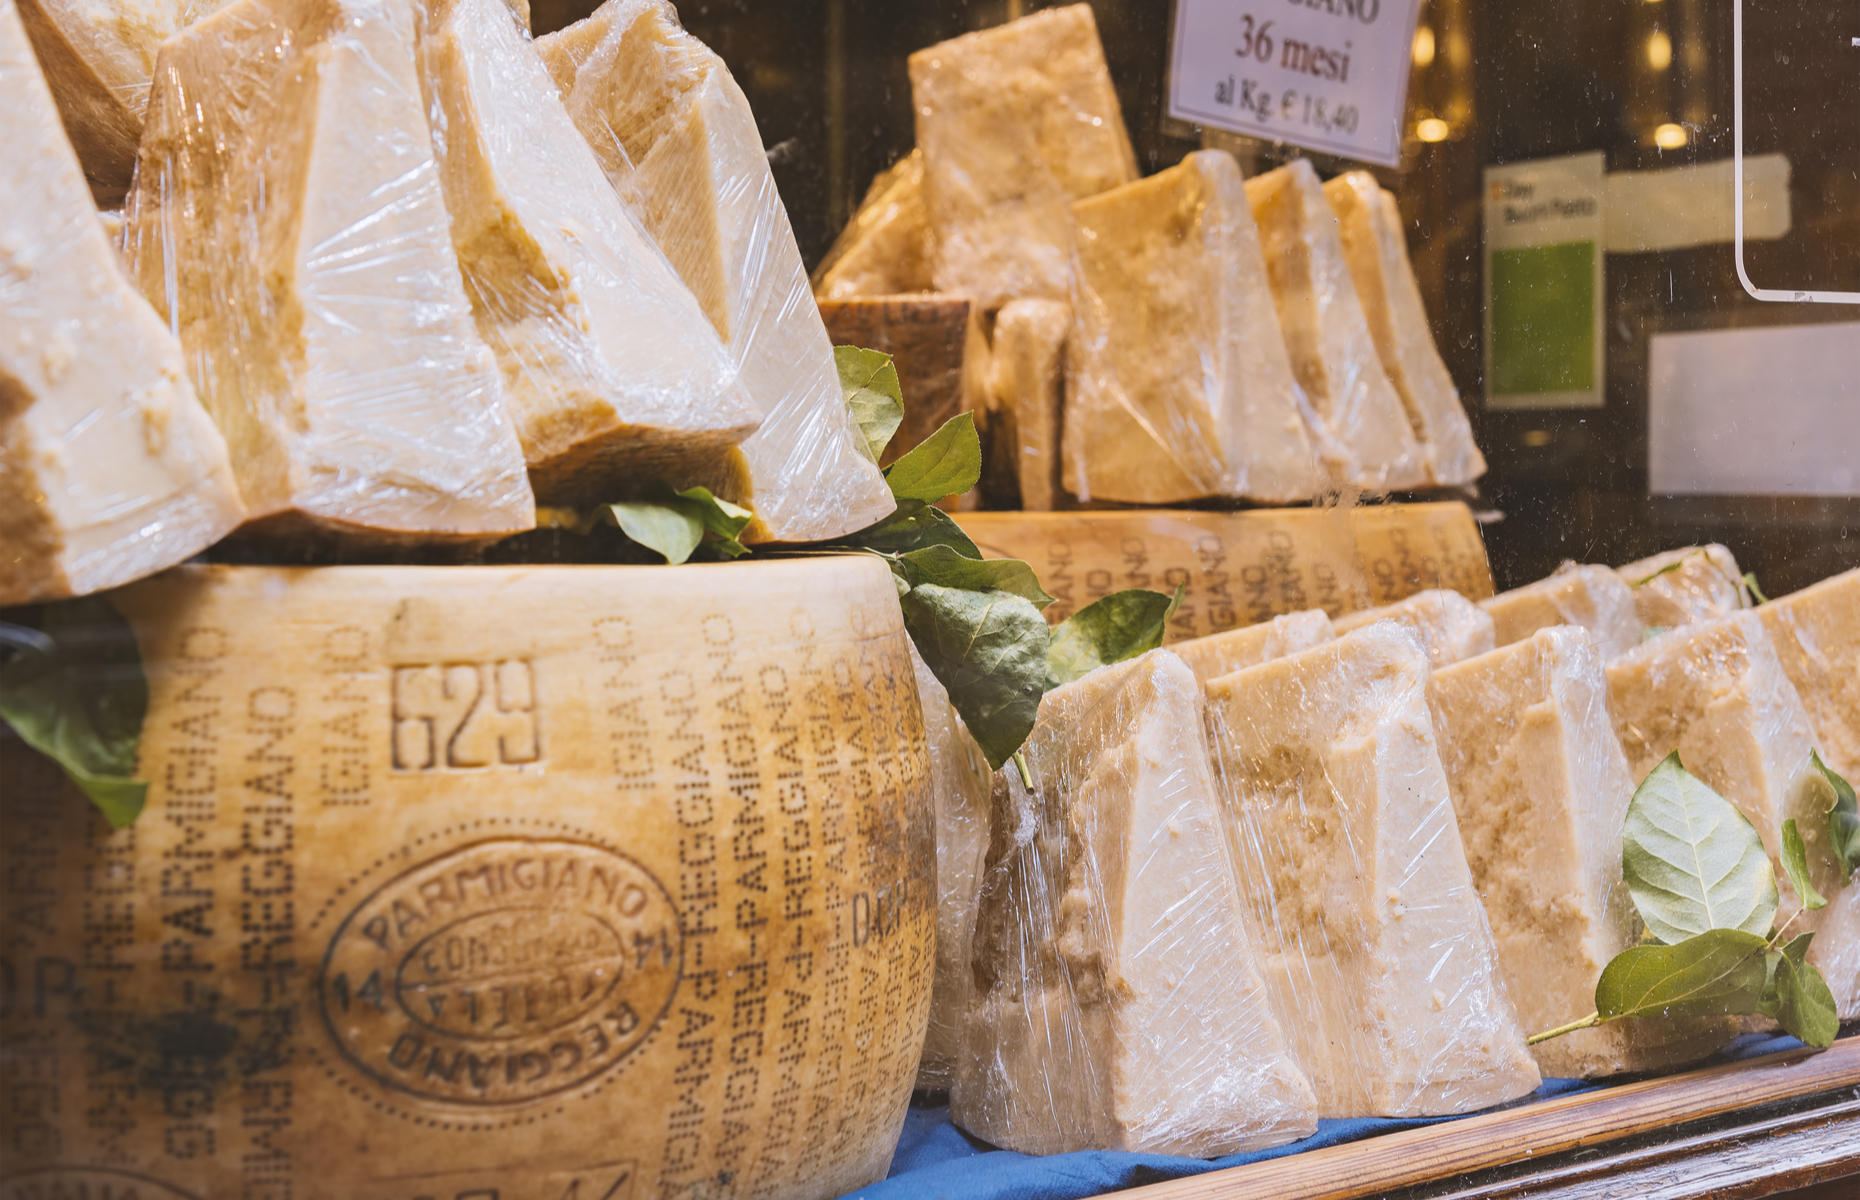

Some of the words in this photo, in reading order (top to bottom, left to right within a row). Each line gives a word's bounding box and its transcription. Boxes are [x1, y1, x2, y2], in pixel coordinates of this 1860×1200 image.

[1214, 74, 1235, 106] al
[1240, 78, 1273, 122] Kg
[1235, 14, 1274, 63] 36
[1280, 40, 1352, 83] mesi
[320, 625, 371, 807] IGIANO
[391, 657, 541, 771] 629
[701, 612, 768, 930] PARMIGIANO
[161, 626, 229, 972] PARMIGIANO
[240, 685, 297, 972] REGGIANO
[659, 667, 718, 935] REGGIANO
[759, 664, 813, 920] REGGIANO
[362, 858, 650, 950] PARMIGIANO
[333, 969, 386, 1014] 14
[387, 1000, 641, 1090] REGGIANO
